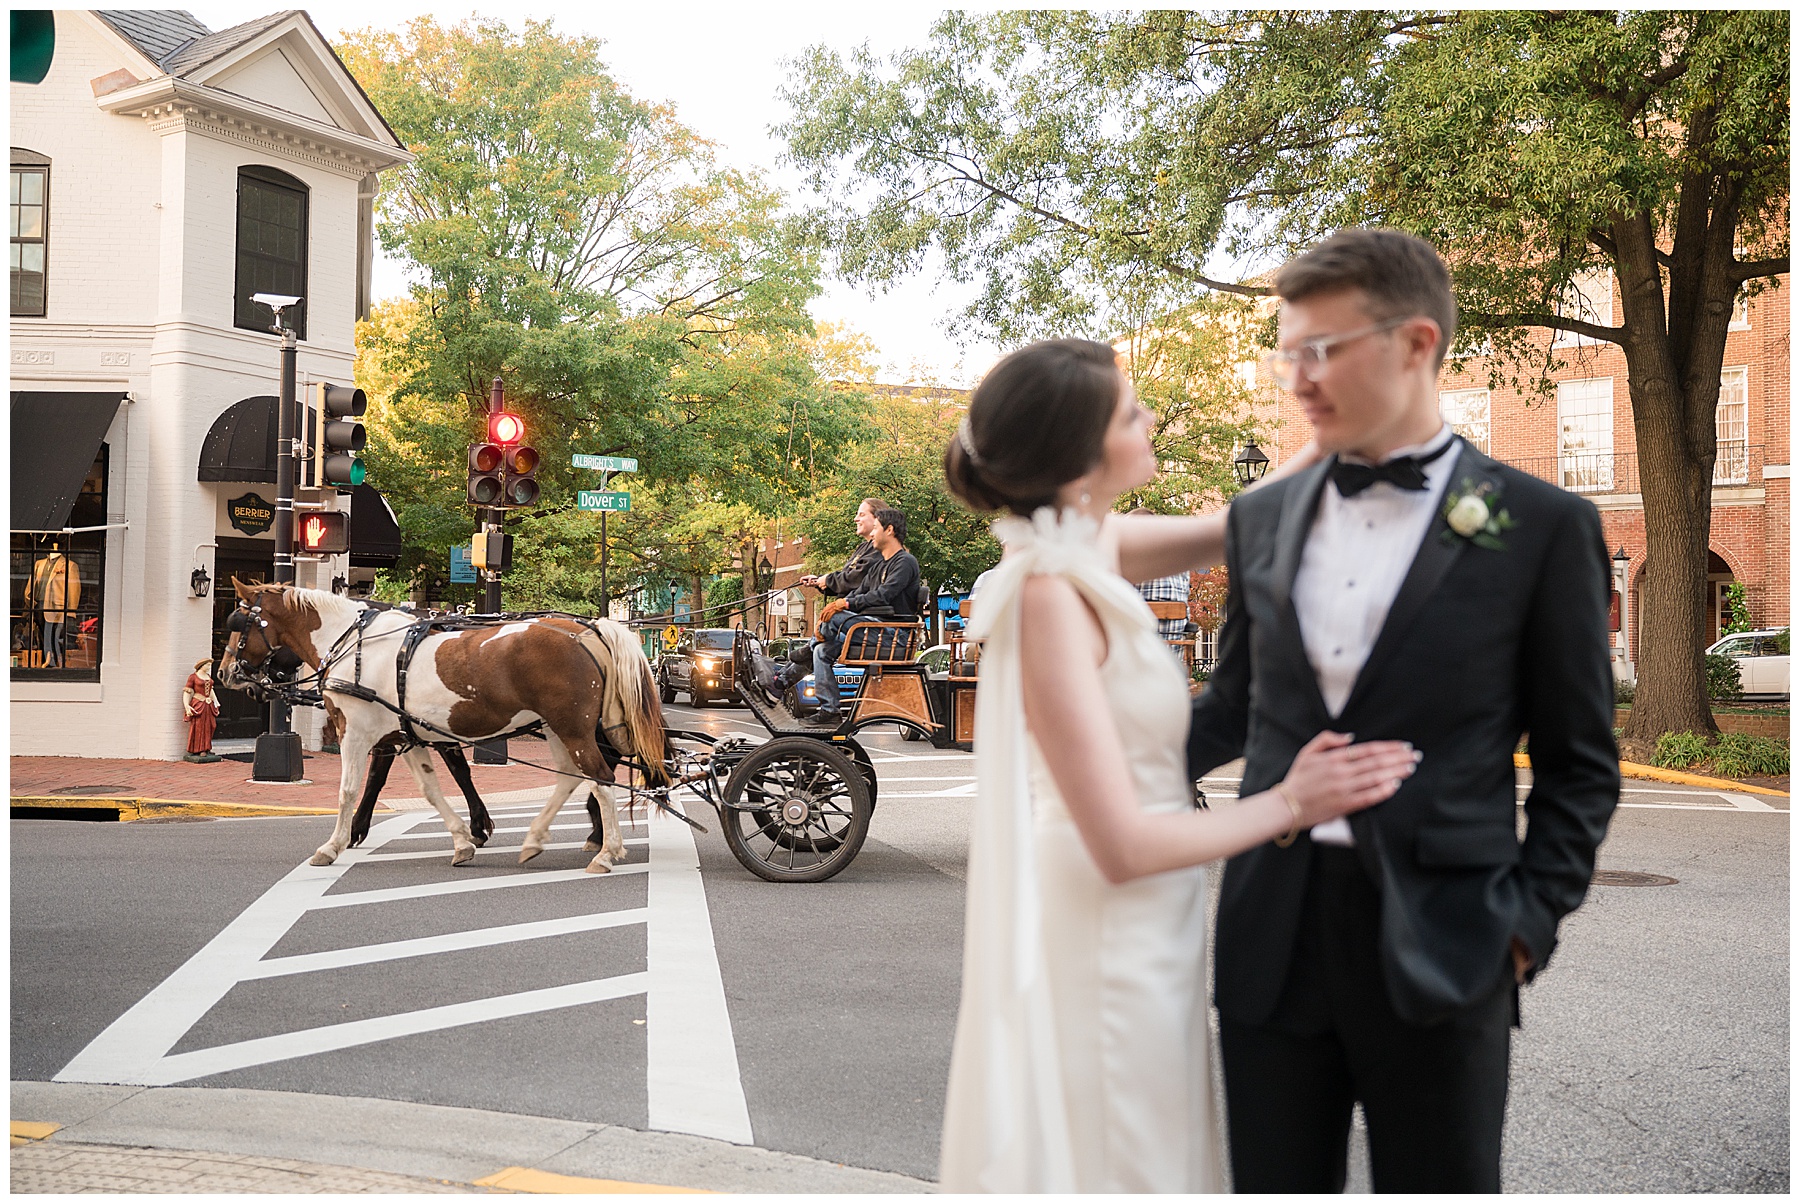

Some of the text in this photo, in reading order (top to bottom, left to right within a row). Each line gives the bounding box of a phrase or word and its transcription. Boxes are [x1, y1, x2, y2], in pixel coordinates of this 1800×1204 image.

[573, 456, 636, 470] ALBRIGHT'S WAY
[581, 492, 628, 508] Dover ST
[234, 506, 271, 519] BERRIER
